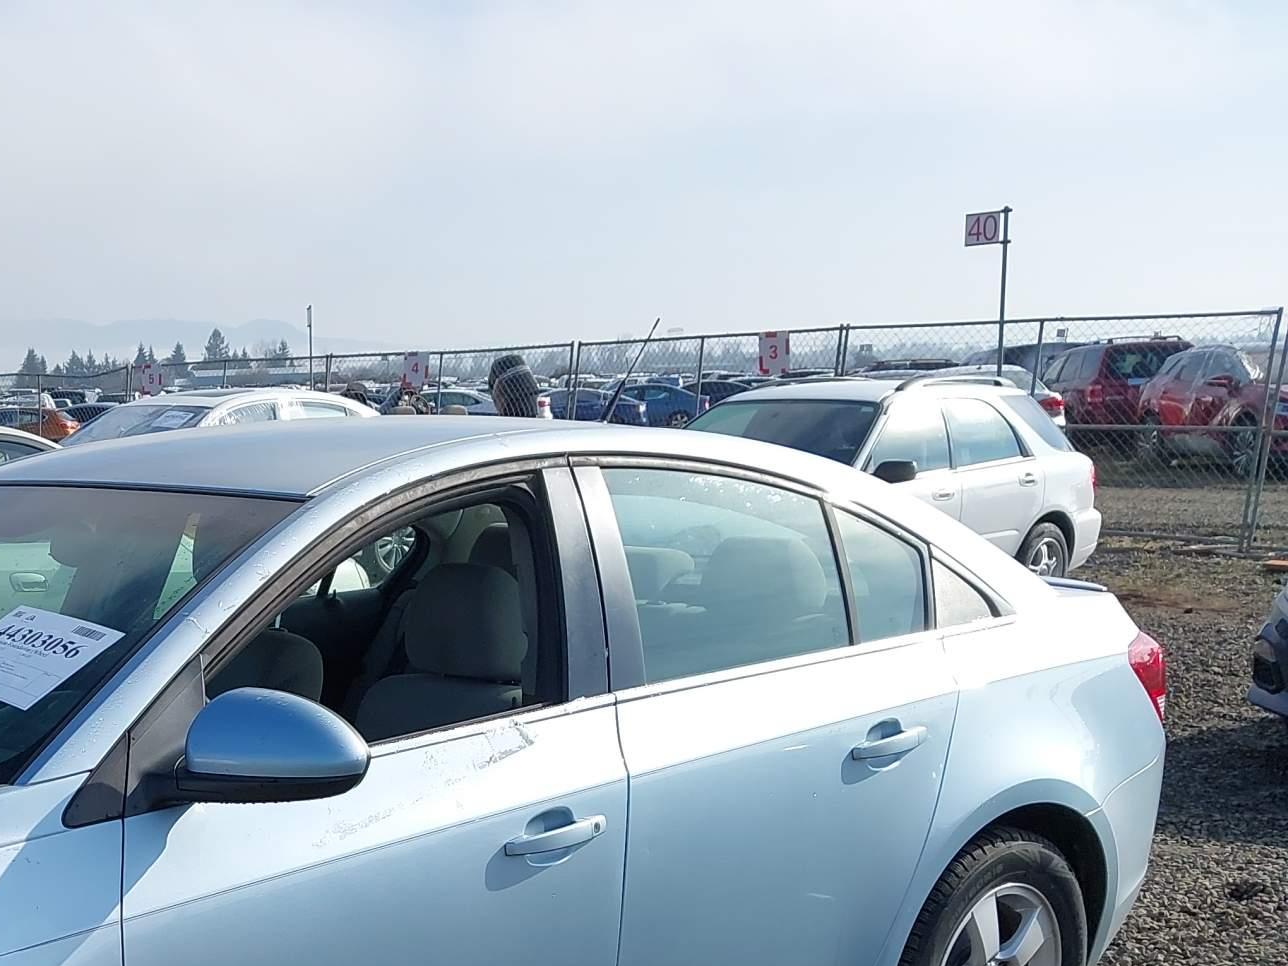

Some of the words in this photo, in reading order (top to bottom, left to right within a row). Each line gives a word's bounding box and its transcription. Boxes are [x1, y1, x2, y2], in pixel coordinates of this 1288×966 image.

[968, 214, 998, 242] 40
[769, 344, 778, 359] 3
[411, 361, 419, 374] 4
